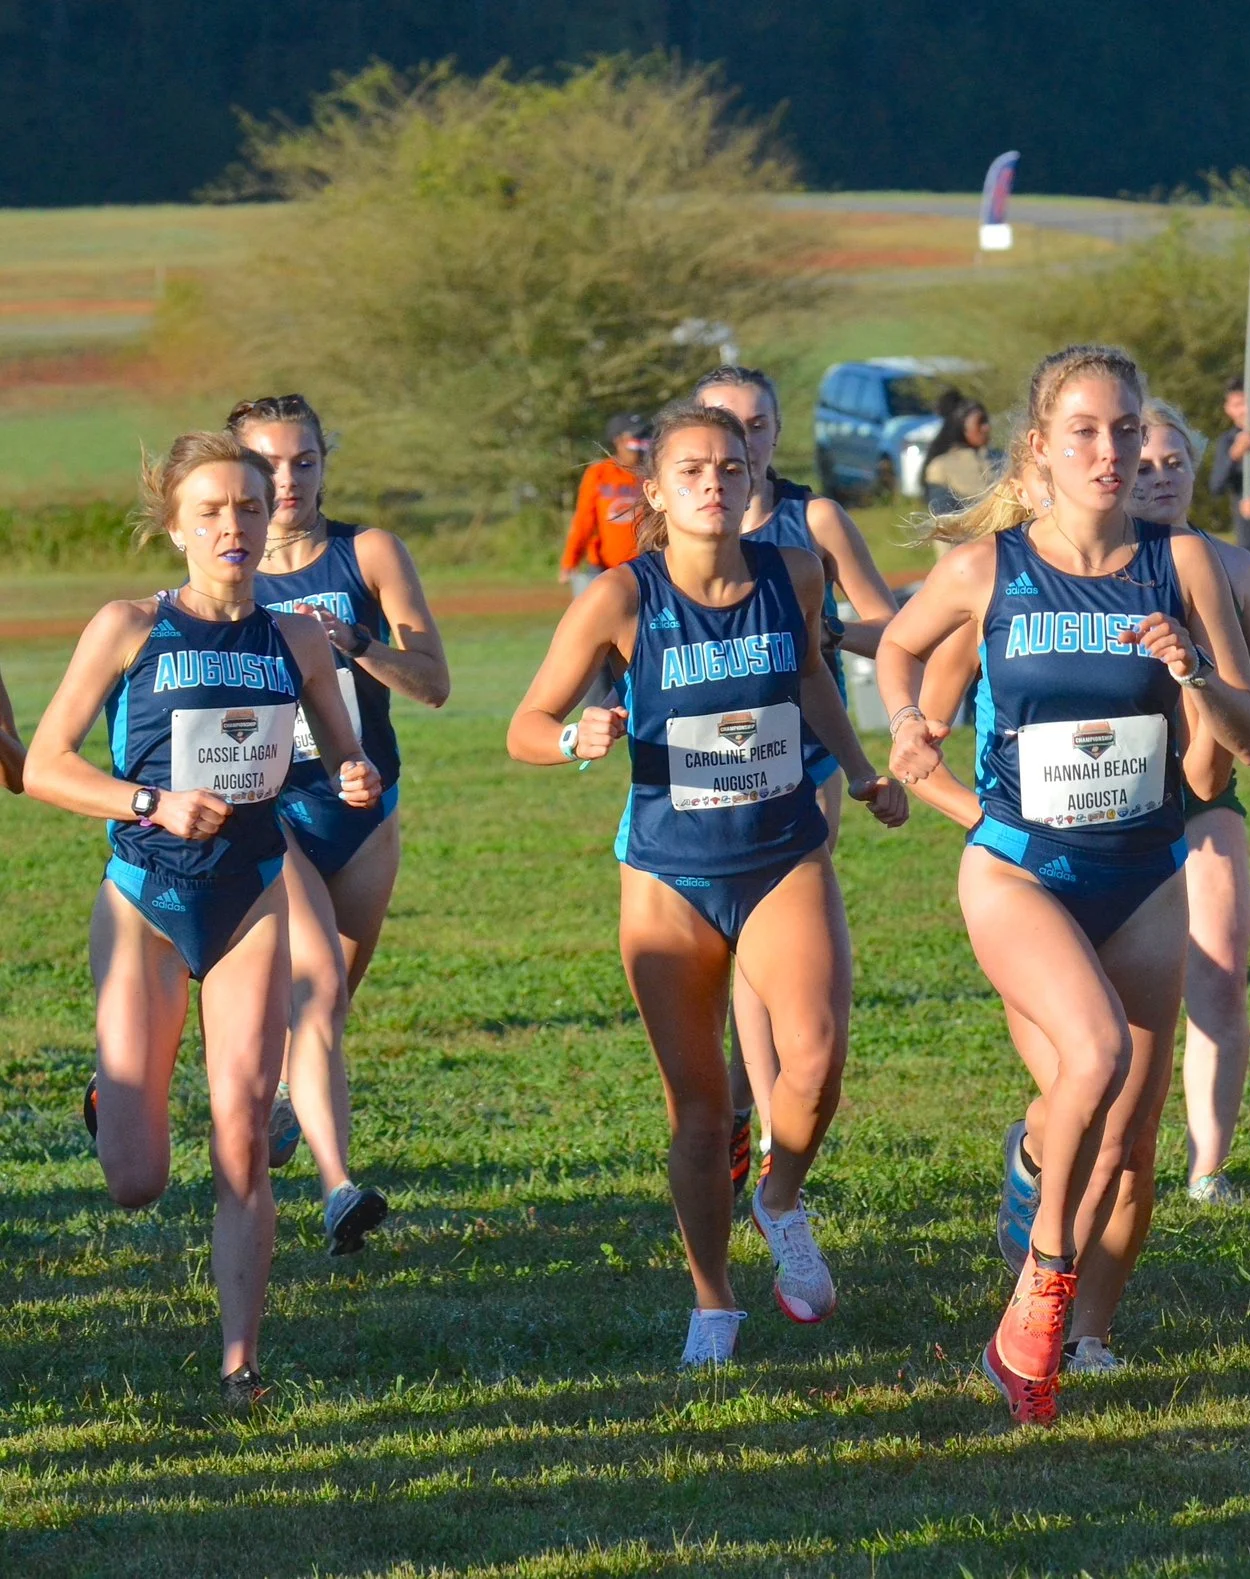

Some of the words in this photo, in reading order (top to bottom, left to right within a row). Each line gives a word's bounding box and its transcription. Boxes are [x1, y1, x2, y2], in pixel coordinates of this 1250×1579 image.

[1005, 585, 1038, 595] adidas
[150, 628, 181, 638] adidas
[650, 619, 680, 629] adidas
[1005, 611, 1154, 660] AUGUST
[661, 632, 797, 690] AUGUSTA
[153, 650, 295, 696] AUGUSTA
[294, 733, 316, 749] GUS
[198, 746, 239, 763] CASSIE
[243, 744, 278, 761] LAGAN
[685, 748, 747, 768] CAROLINE
[750, 739, 787, 762] PIERCE
[1044, 762, 1100, 782] HANNAH
[1104, 757, 1147, 778] BEACH
[213, 772, 265, 790] AUGUSTA
[713, 771, 768, 792] AUGUSTA
[1068, 788, 1128, 810] AUGUSTA
[675, 878, 711, 887] adidas
[1039, 867, 1077, 882] adidas
[152, 899, 186, 912] adidas
